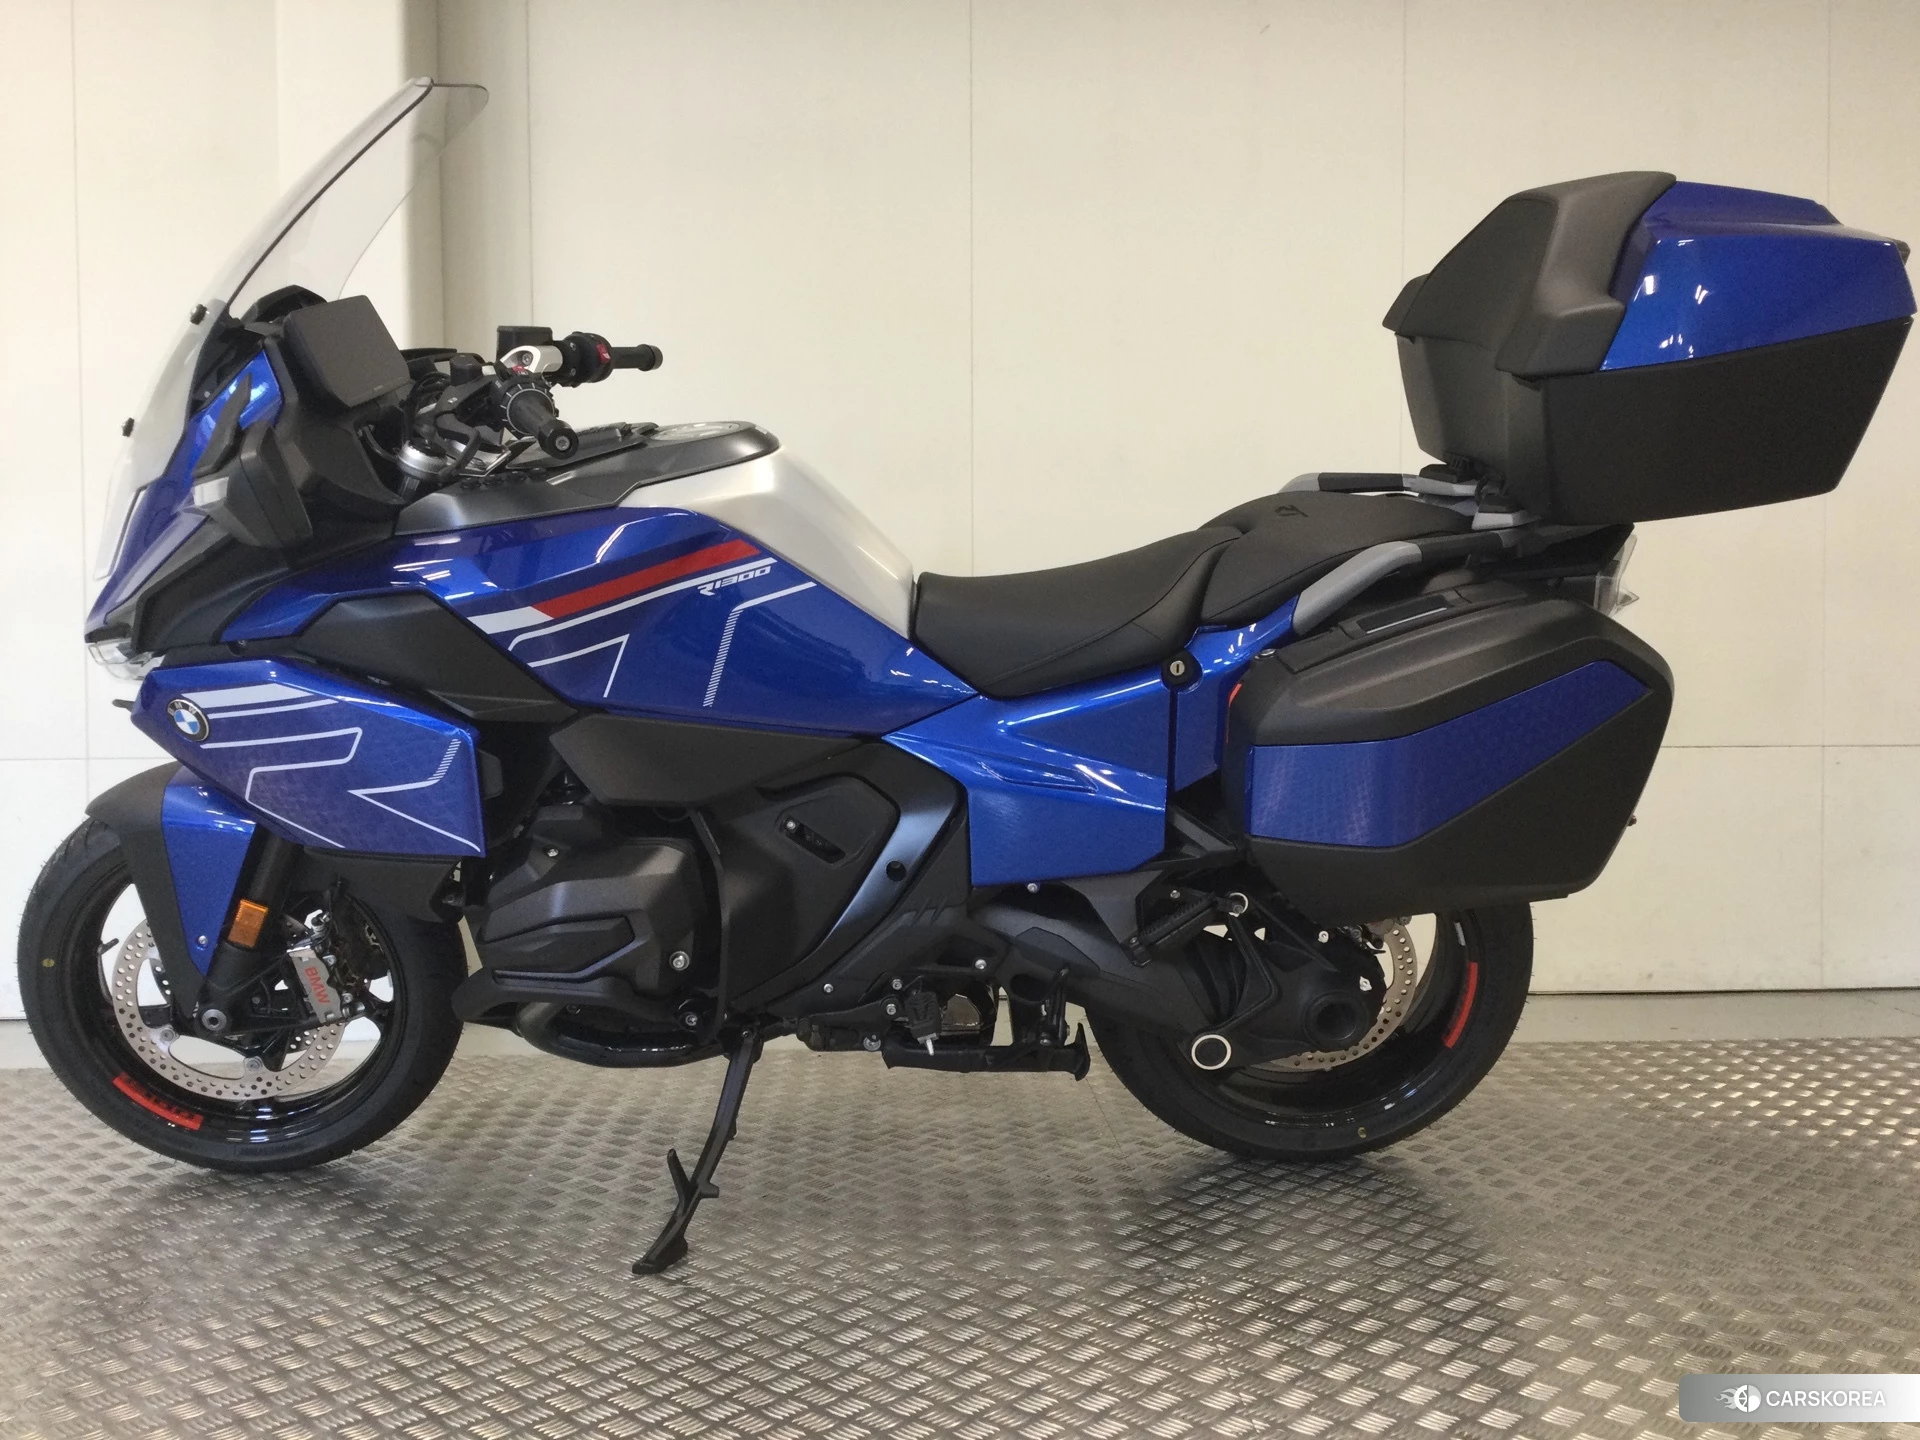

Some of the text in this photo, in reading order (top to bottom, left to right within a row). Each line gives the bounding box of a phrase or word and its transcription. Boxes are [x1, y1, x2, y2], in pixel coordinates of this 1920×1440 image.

[698, 565, 772, 597] R1300
[167, 701, 198, 716] BMW
[304, 966, 331, 1004] BMW
